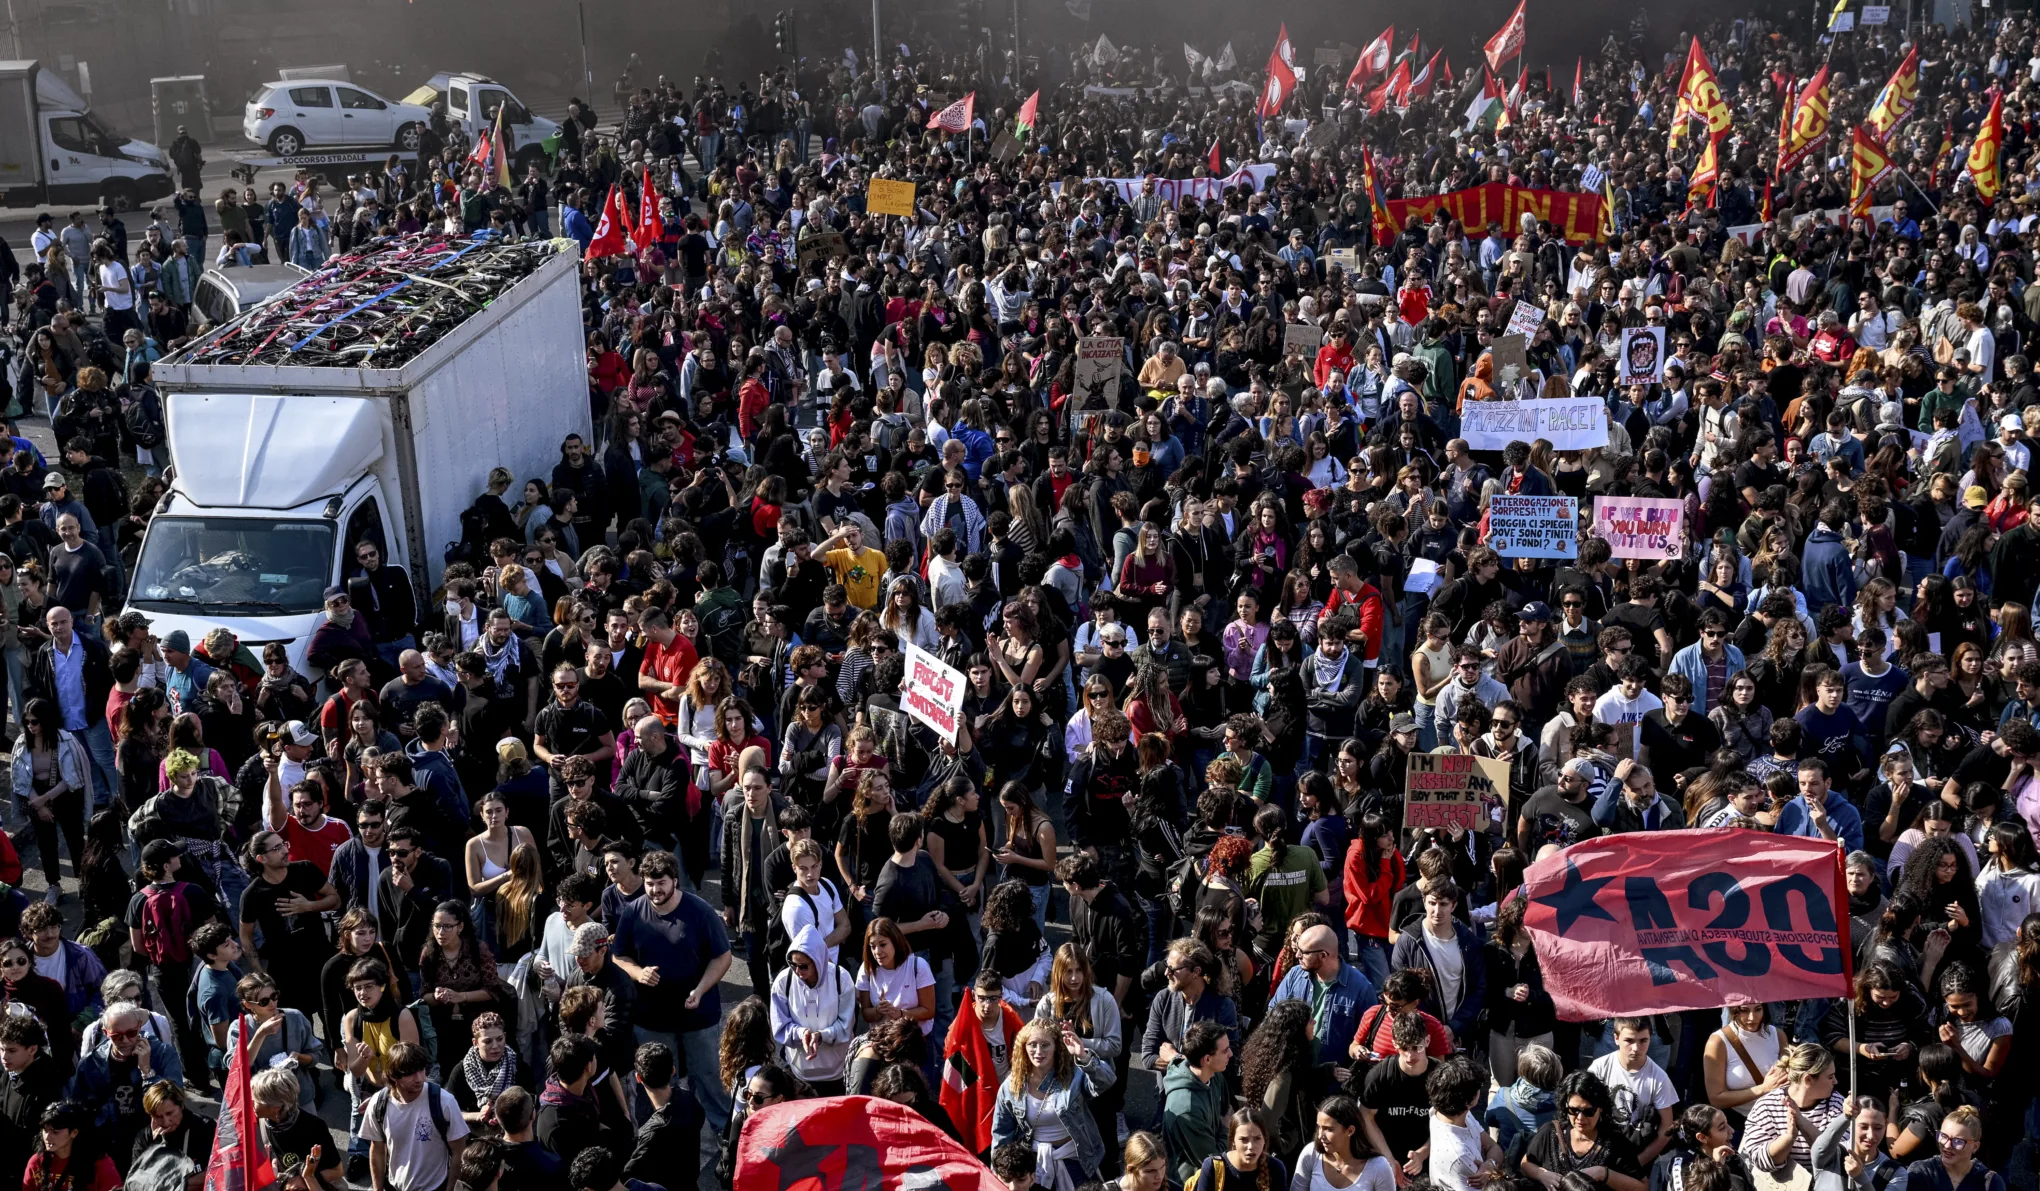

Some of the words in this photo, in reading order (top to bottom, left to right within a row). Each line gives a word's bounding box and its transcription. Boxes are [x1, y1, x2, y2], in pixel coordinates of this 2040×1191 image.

[283, 154, 325, 165] SOCCORSO
[326, 152, 366, 163] STRADALE
[1520, 313, 1540, 326] FUTURO
[1628, 328, 1648, 336] EAT
[1082, 341, 1094, 349] LA
[1625, 374, 1657, 385] RICH
[1462, 407, 1539, 432] MAZZINI
[1548, 405, 1598, 431] PACE!
[1491, 497, 1569, 508] INTERROGAZIONE
[1570, 498, 1576, 507] A
[1601, 506, 1617, 521] IF
[1620, 506, 1643, 521] WE
[1646, 507, 1679, 522] BURN
[1491, 518, 1527, 529] GIOGGIA
[1529, 519, 1538, 528] CI
[1539, 519, 1574, 530] SPIEGHI
[1610, 520, 1636, 534] YOU
[1636, 520, 1672, 536] BURN
[1492, 528, 1517, 538] DOVE
[1518, 528, 1543, 538] SONO
[1545, 529, 1574, 540] FINITI
[1510, 537, 1514, 547] I
[1607, 533, 1646, 549] WITH
[1647, 535, 1668, 549] US
[1411, 755, 1434, 772] I'M
[1441, 755, 1476, 773] NOT
[1467, 775, 1494, 793] ANY
[1410, 790, 1431, 802] BOY
[1434, 791, 1460, 801] THAT
[1465, 791, 1475, 802] IS
[1388, 1105, 1430, 1117] ANTI-FASC
